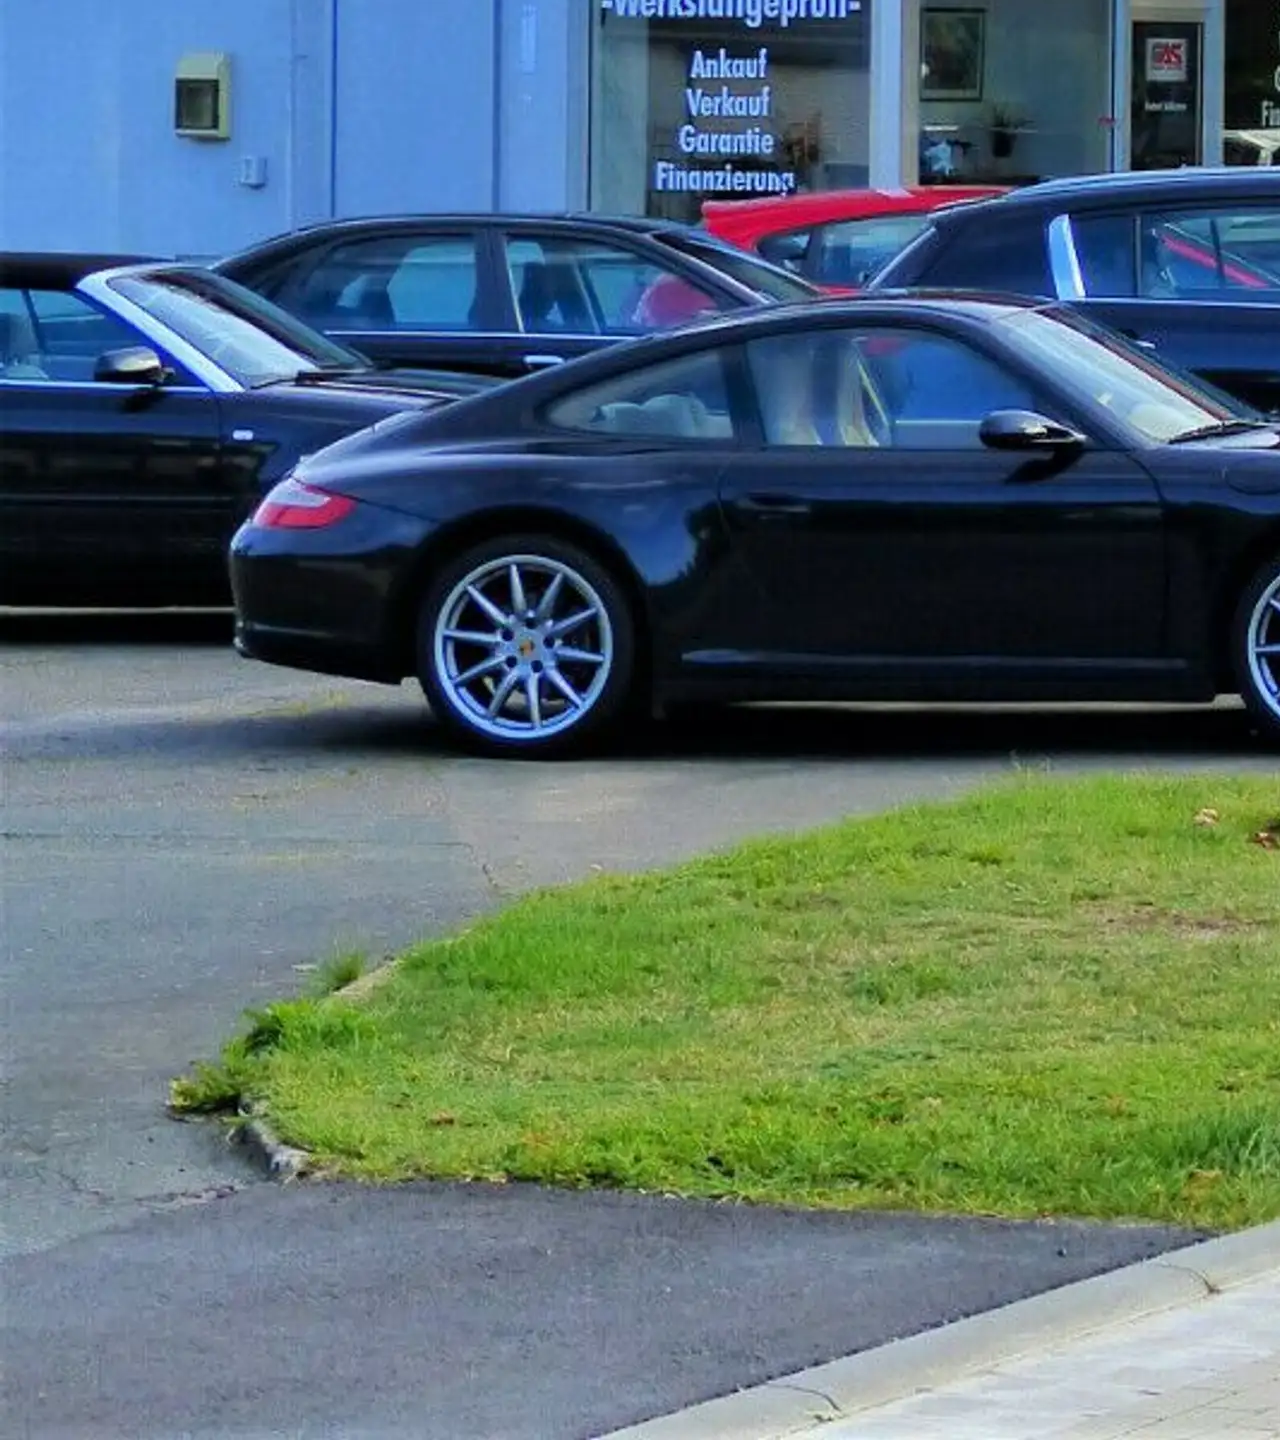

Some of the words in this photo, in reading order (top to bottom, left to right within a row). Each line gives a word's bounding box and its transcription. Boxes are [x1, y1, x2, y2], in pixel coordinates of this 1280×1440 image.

[690, 47, 768, 79] Ankauf
[686, 85, 770, 117] Verkauf
[678, 124, 774, 155] Garantie
[655, 160, 795, 197] Finanzierung
